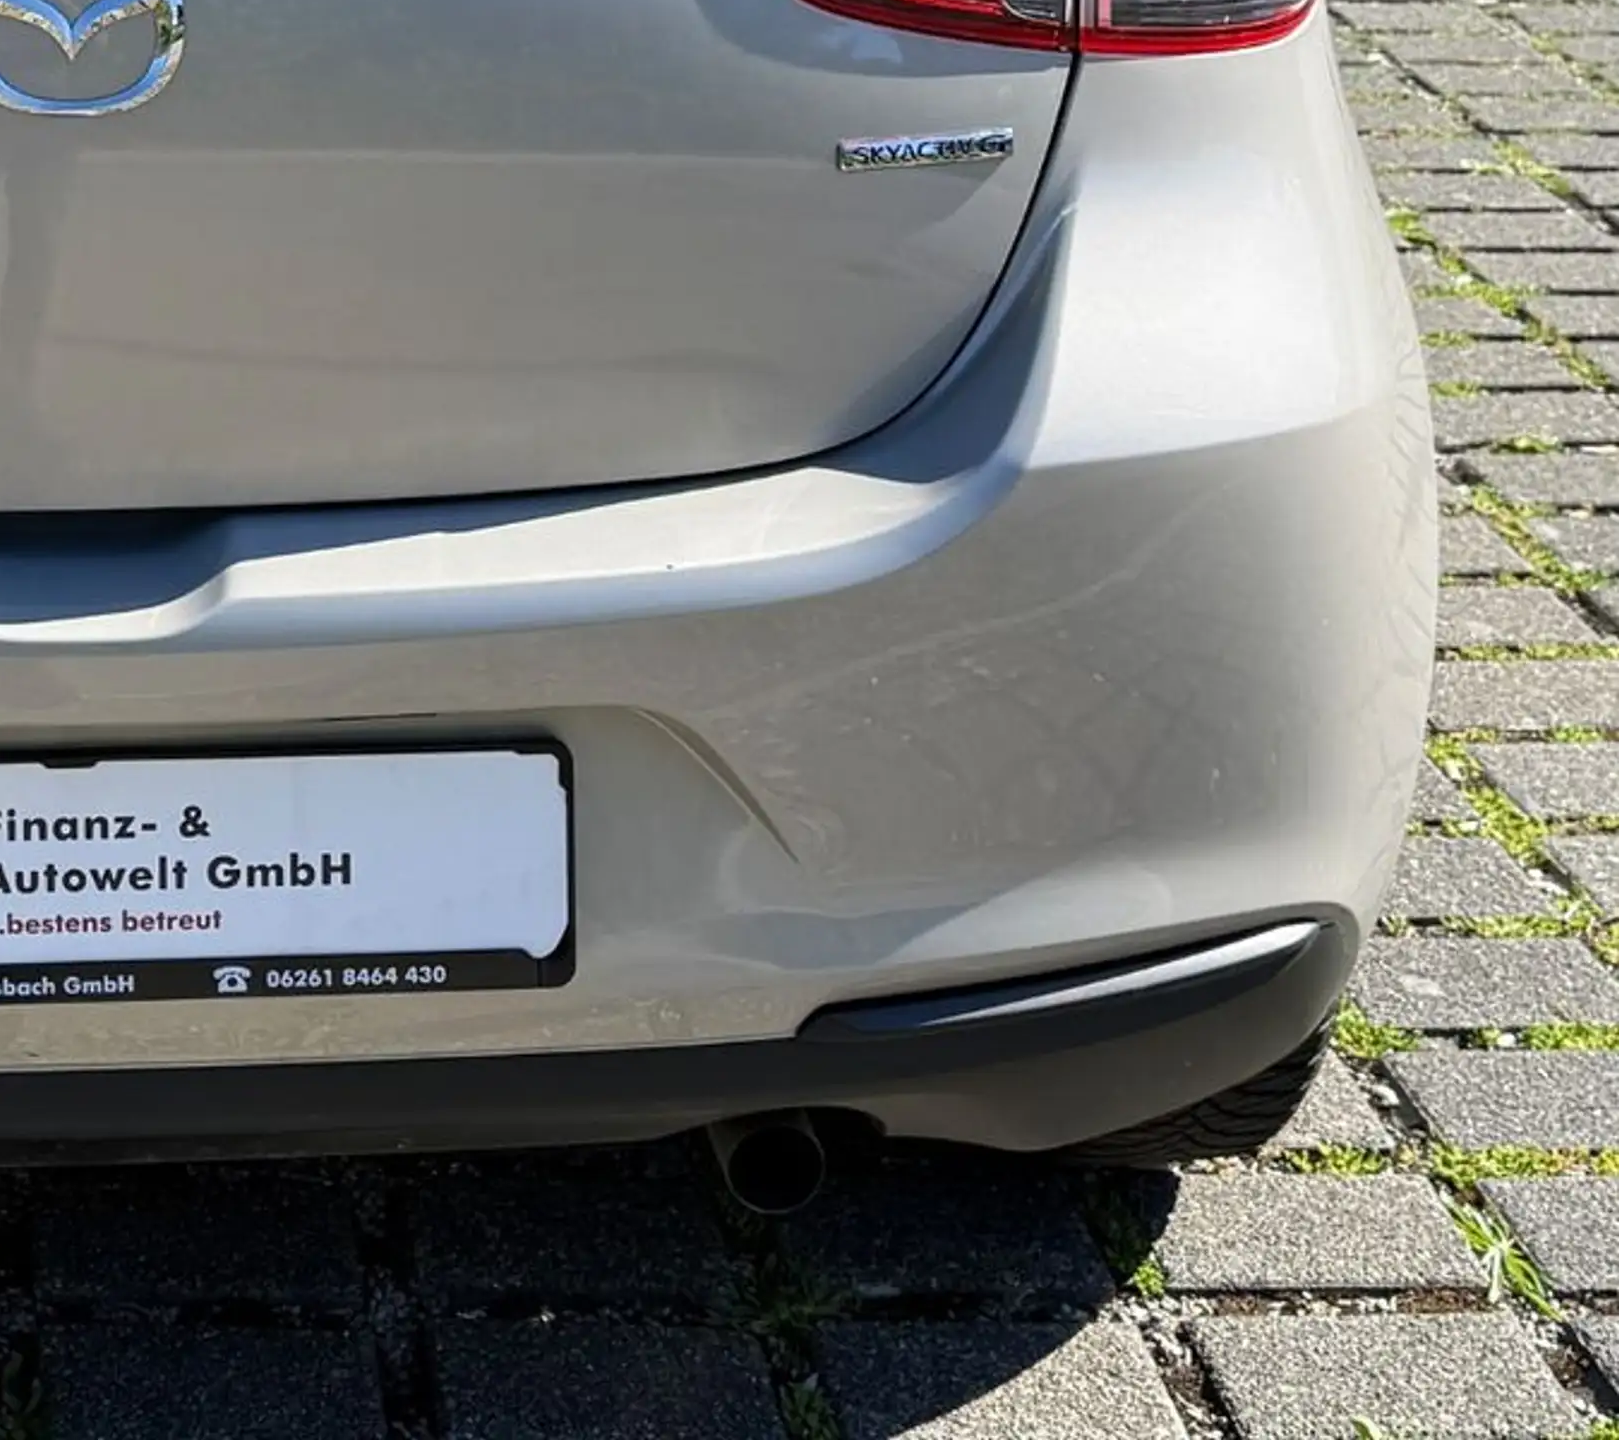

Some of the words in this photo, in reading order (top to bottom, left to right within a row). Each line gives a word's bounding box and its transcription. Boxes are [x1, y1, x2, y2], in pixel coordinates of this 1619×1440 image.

[180, 805, 211, 838] &
[207, 852, 353, 889] GmbH
[121, 910, 223, 932] betreut
[63, 974, 135, 994] GmbH
[266, 969, 332, 988] 06261
[342, 967, 398, 986] 8464
[404, 965, 447, 984] 430
